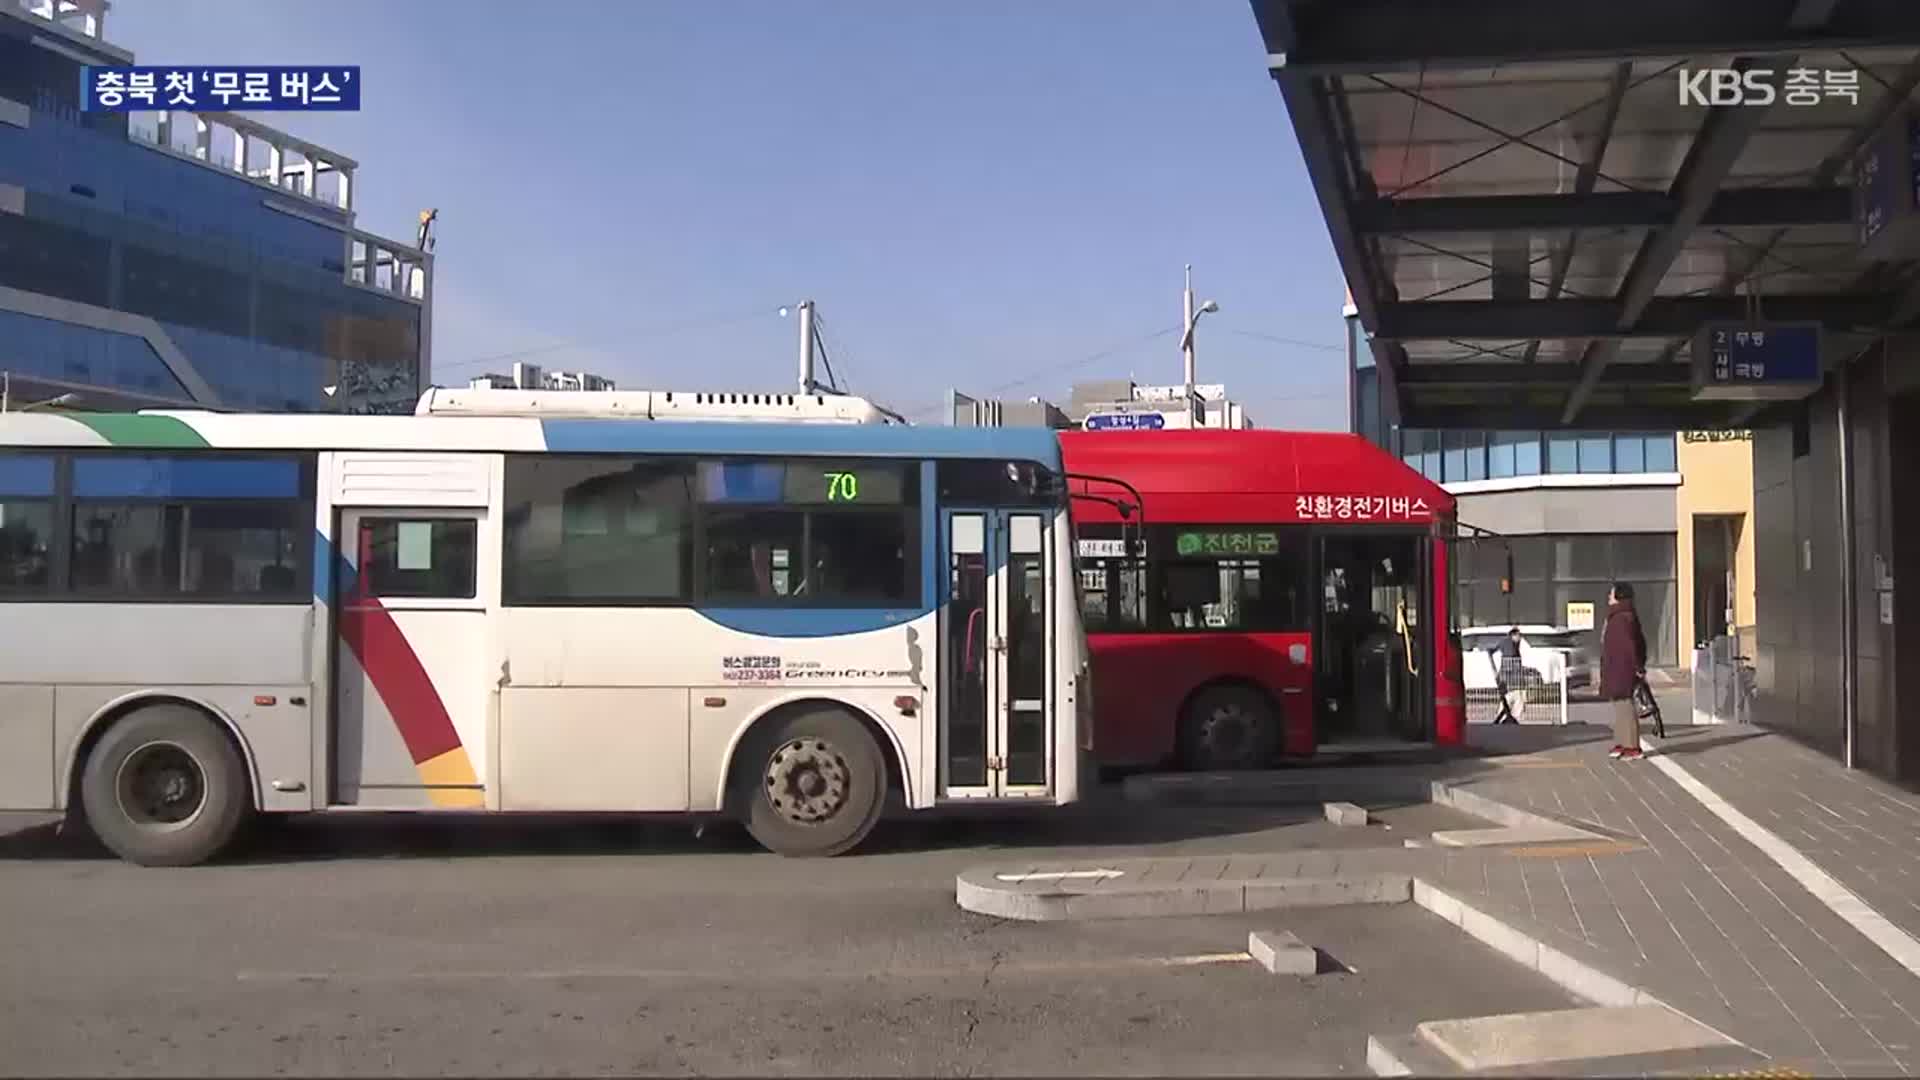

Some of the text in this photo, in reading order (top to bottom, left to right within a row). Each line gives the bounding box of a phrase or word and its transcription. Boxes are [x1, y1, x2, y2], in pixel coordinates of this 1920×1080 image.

[823, 473, 857, 500] 70
[1296, 495, 1431, 519] 친환경전기버스
[1205, 532, 1279, 556] 진천군
